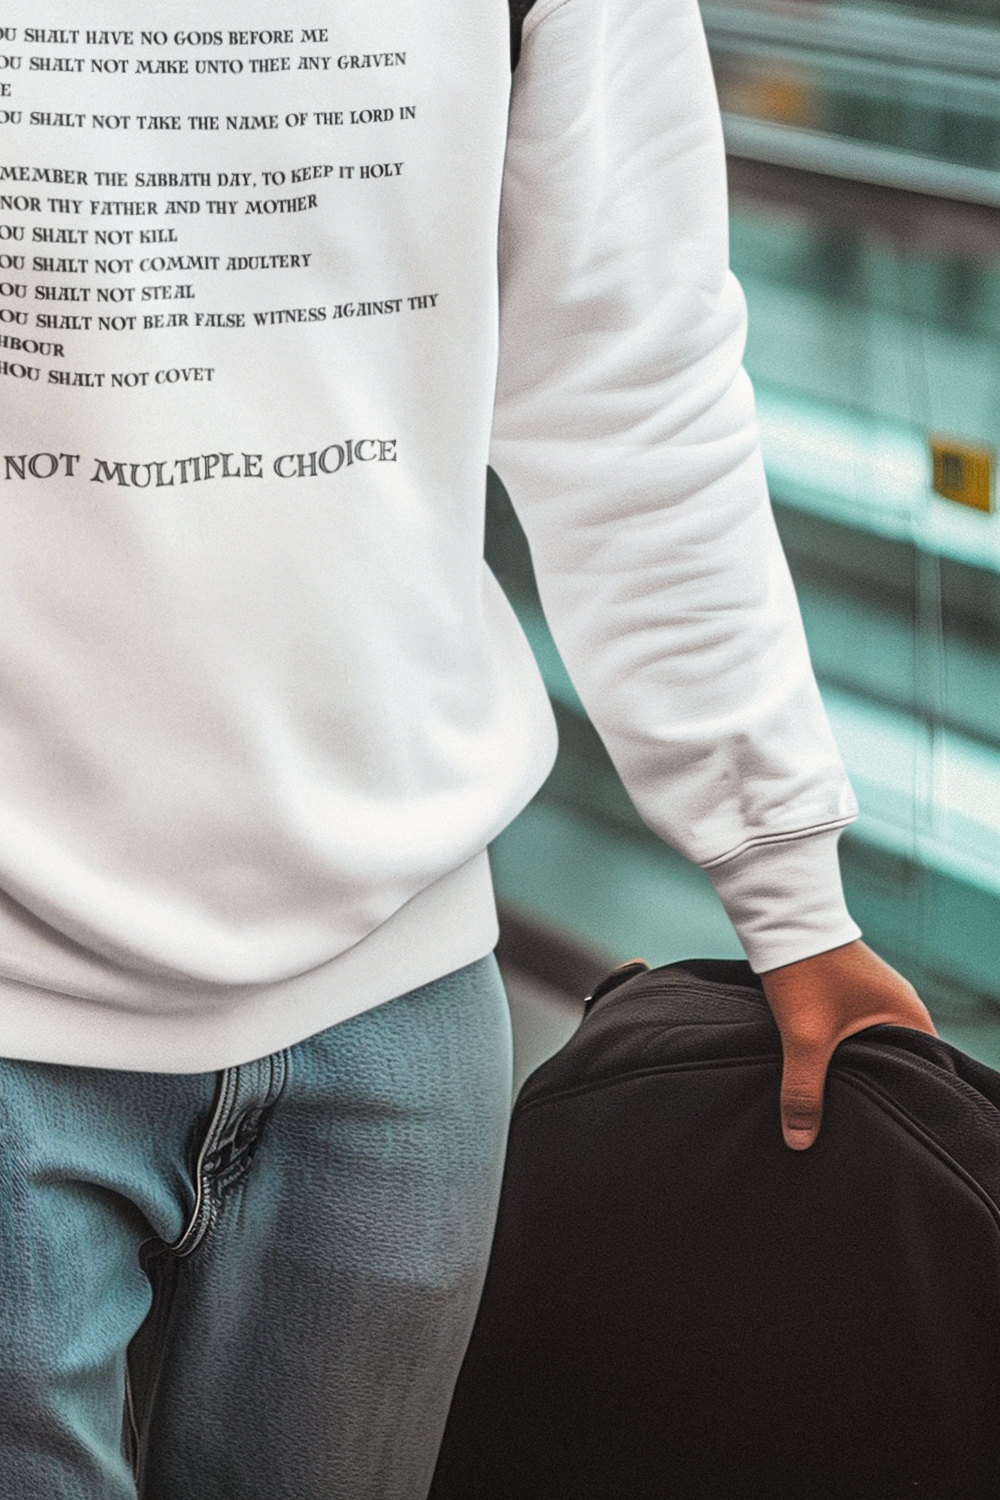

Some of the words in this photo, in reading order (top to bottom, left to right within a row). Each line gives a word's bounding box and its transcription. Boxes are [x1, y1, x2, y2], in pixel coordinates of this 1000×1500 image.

[23, 27, 81, 45] SHALT
[85, 30, 134, 46] HAVE
[140, 30, 169, 46] NO
[173, 30, 224, 46] GODS
[227, 29, 294, 46] BEFORE
[300, 27, 329, 44] ME
[28, 56, 86, 73] SHALT
[90, 58, 130, 74] NOT
[134, 59, 189, 75] MAKE
[194, 58, 245, 75] UNTO
[248, 56, 291, 74] THEE
[297, 55, 332, 71] ANY
[336, 51, 407, 70] GRAVEN
[29, 110, 87, 128] SHALT
[91, 114, 132, 130] NOT
[135, 115, 182, 131] TAKE
[187, 115, 220, 131] THE
[225, 114, 279, 131] NAME
[284, 112, 309, 128] OF
[312, 111, 344, 126] THE
[349, 107, 395, 125] LORD
[399, 105, 417, 121] IN
[93, 171, 128, 188] THE
[134, 172, 212, 188] SABBATH
[216, 172, 257, 188] DAY,
[261, 170, 287, 187] TO
[290, 164, 335, 184] KEEP
[338, 165, 355, 180] IT
[359, 161, 404, 180] HOLY
[46, 197, 84, 215] THY
[89, 199, 159, 217] FATHER
[164, 200, 201, 215] AND
[205, 199, 239, 215] THY
[244, 193, 319, 215] MOTHER
[31, 226, 89, 245] SHALT
[93, 229, 134, 246] NOT
[139, 228, 178, 244] KILL
[32, 256, 89, 274] SHALT
[94, 258, 134, 275] NOT
[138, 255, 221, 272] COMMIT
[225, 252, 313, 272] ADULTERY
[34, 284, 91, 303] SHALT
[96, 287, 136, 303] NOT
[141, 284, 196, 302] STEAL
[35, 313, 93, 331] SHALT
[97, 315, 137, 332] NOT
[142, 312, 190, 330] BEAR
[194, 312, 246, 329] FALSE
[252, 306, 328, 327] WITNESS
[332, 298, 403, 320] AGAINST
[406, 293, 439, 311] THY
[47, 369, 106, 388] SHALT
[110, 371, 150, 388] NOT
[154, 366, 216, 385] COVET
[3, 452, 81, 481] NOT
[89, 451, 264, 489] MULTIPLE
[272, 438, 398, 479] CHOICE
